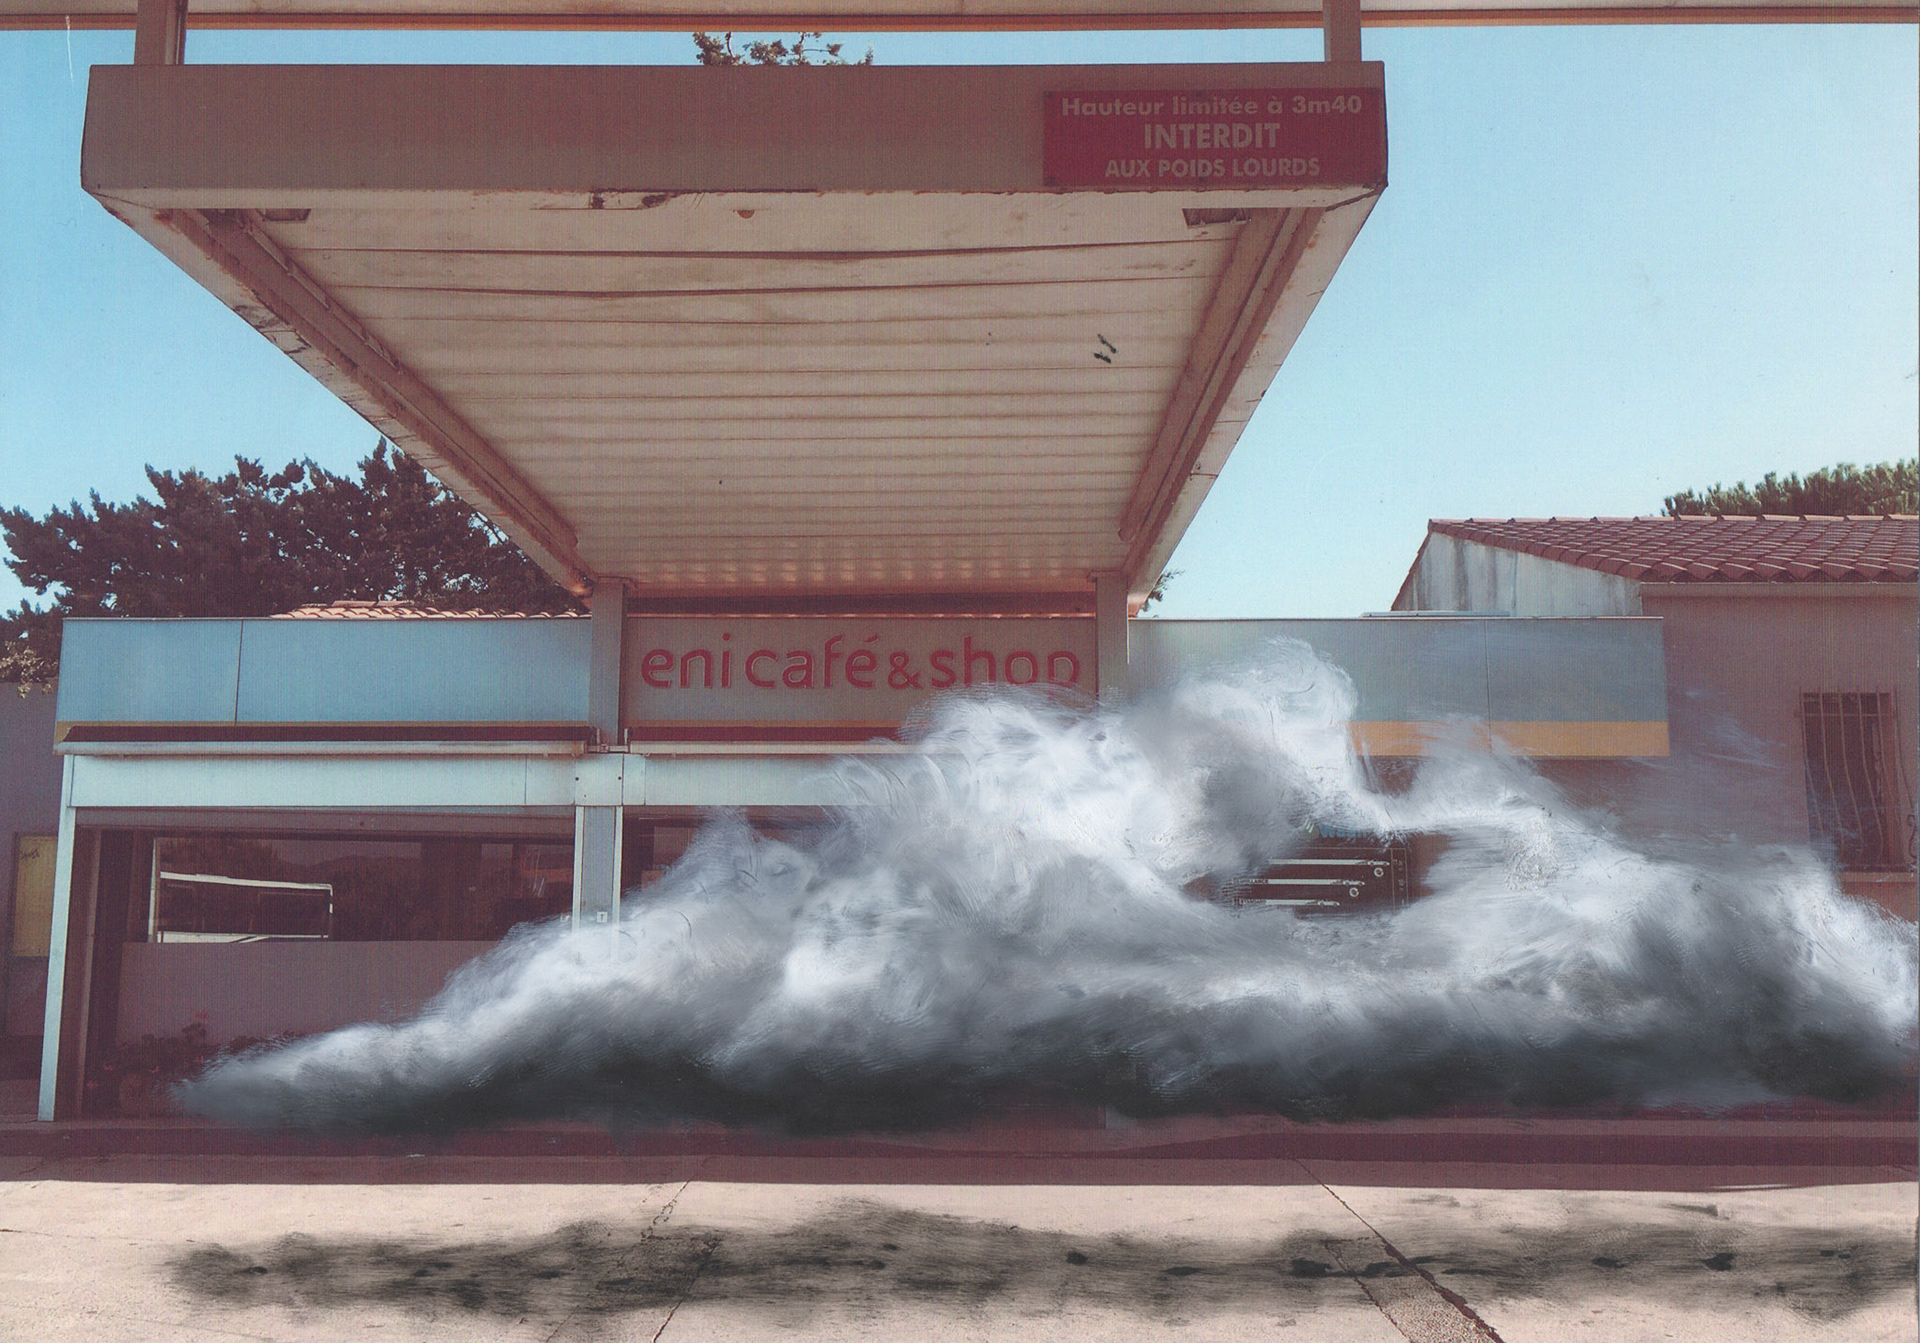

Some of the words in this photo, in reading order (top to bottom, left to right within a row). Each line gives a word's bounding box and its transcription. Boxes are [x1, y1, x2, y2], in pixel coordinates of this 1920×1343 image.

[1061, 96, 1164, 116] Hauteur
[1172, 95, 1258, 116] limitée
[1267, 95, 1284, 114] à
[1291, 95, 1363, 115] 3m40
[1145, 122, 1280, 150] INTERDIT
[1105, 159, 1150, 178] AUX
[1159, 158, 1225, 178] POIDS
[1232, 157, 1321, 177] LOURDS
